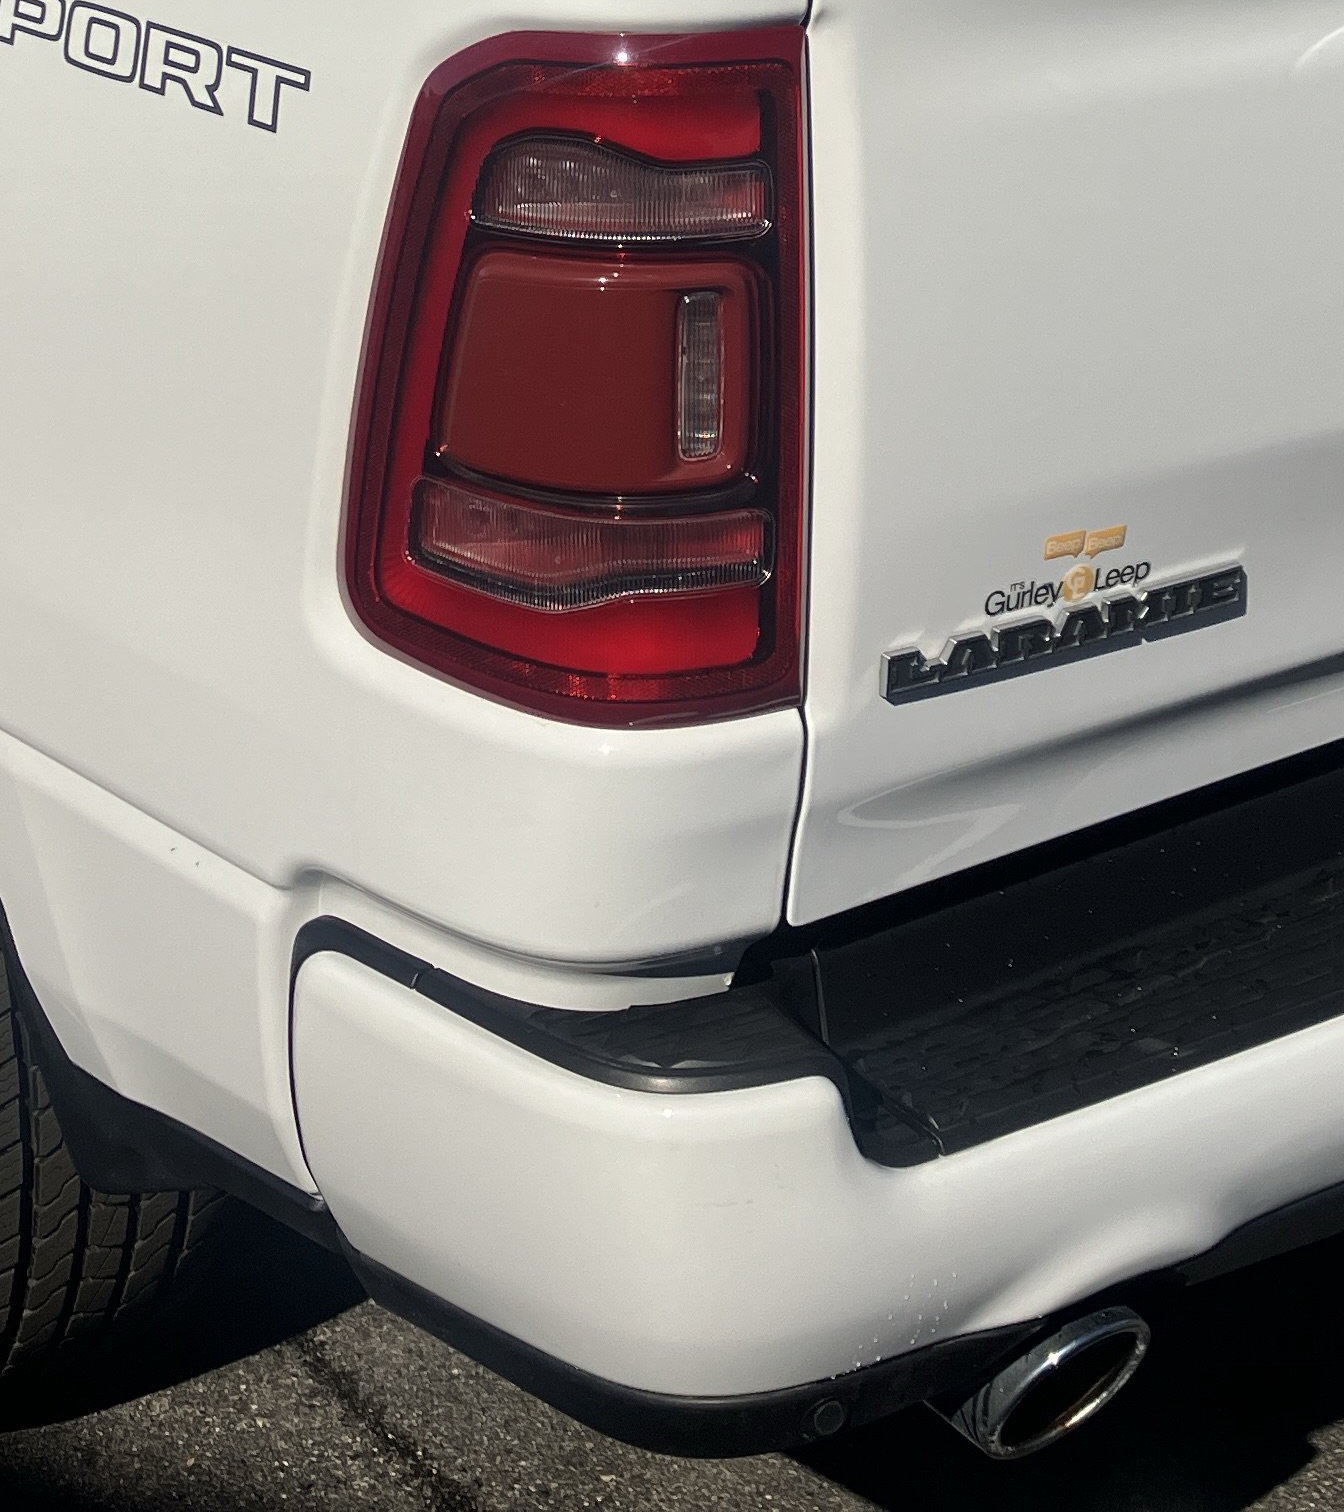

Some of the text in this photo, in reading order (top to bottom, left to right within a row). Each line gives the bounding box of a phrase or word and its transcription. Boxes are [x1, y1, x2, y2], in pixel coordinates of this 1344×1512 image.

[879, 564, 1249, 707] LARAMIE
[984, 581, 1064, 617] Gurley
[1093, 561, 1152, 592] Leep
